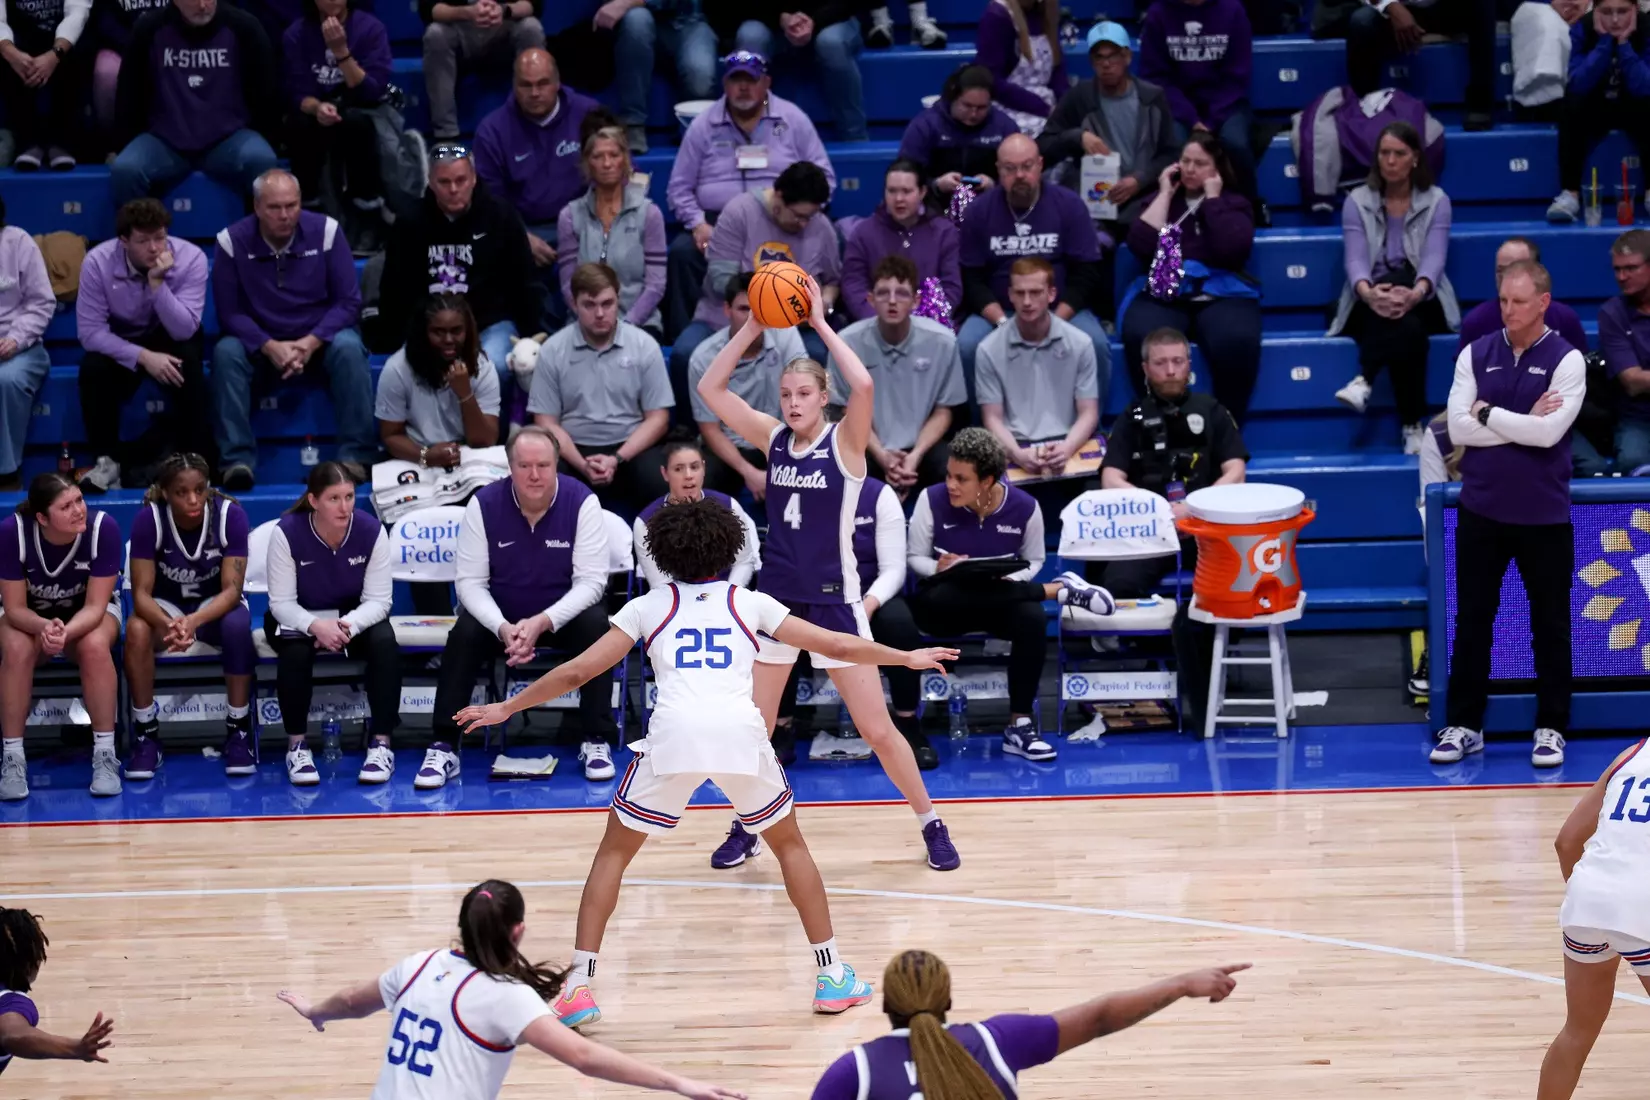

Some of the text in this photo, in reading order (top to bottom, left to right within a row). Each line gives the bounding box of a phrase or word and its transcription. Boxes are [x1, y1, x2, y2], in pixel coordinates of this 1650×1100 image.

[163, 48, 230, 68] K-STATE
[990, 233, 1059, 251] K-STATE
[771, 463, 828, 489] Wildcats
[783, 493, 802, 530] 4
[1077, 497, 1156, 520] Capitol
[400, 520, 460, 543] Capit
[1078, 518, 1157, 539] Federal
[401, 545, 455, 564] Fede
[1254, 538, 1281, 573] G
[158, 561, 221, 585] Wildcats
[676, 628, 732, 669] 25
[1091, 680, 1172, 692] Capitol Federal
[33, 703, 70, 718] Capitol
[163, 702, 227, 716] Capitol Fede
[403, 693, 435, 707] Capito
[388, 1008, 442, 1077] 52
